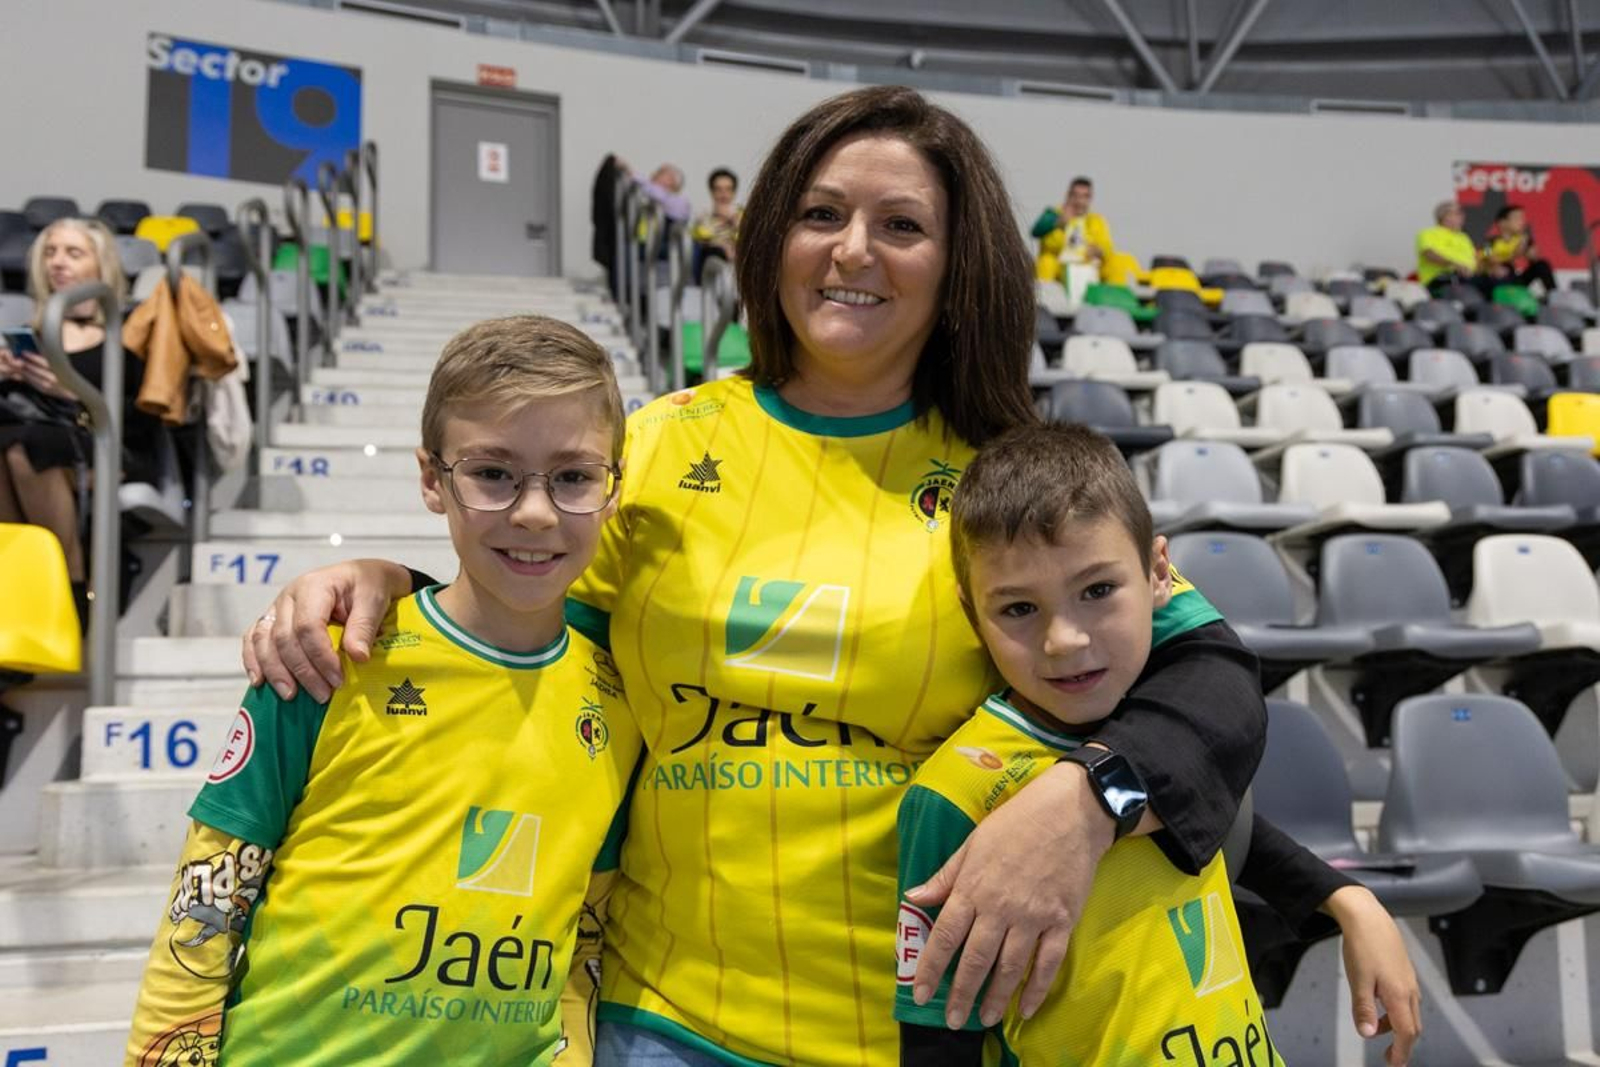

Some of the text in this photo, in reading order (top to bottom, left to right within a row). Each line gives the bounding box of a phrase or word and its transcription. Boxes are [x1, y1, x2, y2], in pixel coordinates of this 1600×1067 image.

[148, 36, 289, 88] Sector
[172, 37, 362, 192] 19
[1453, 161, 1551, 192] Sector
[678, 480, 721, 493] luanvi
[210, 554, 280, 584] F17
[386, 706, 427, 716] luanvi
[105, 720, 199, 769] F16
[643, 753, 763, 790] ARAÍSO
[384, 904, 554, 991] Jaén
[342, 987, 466, 1021] PARAÍSO
